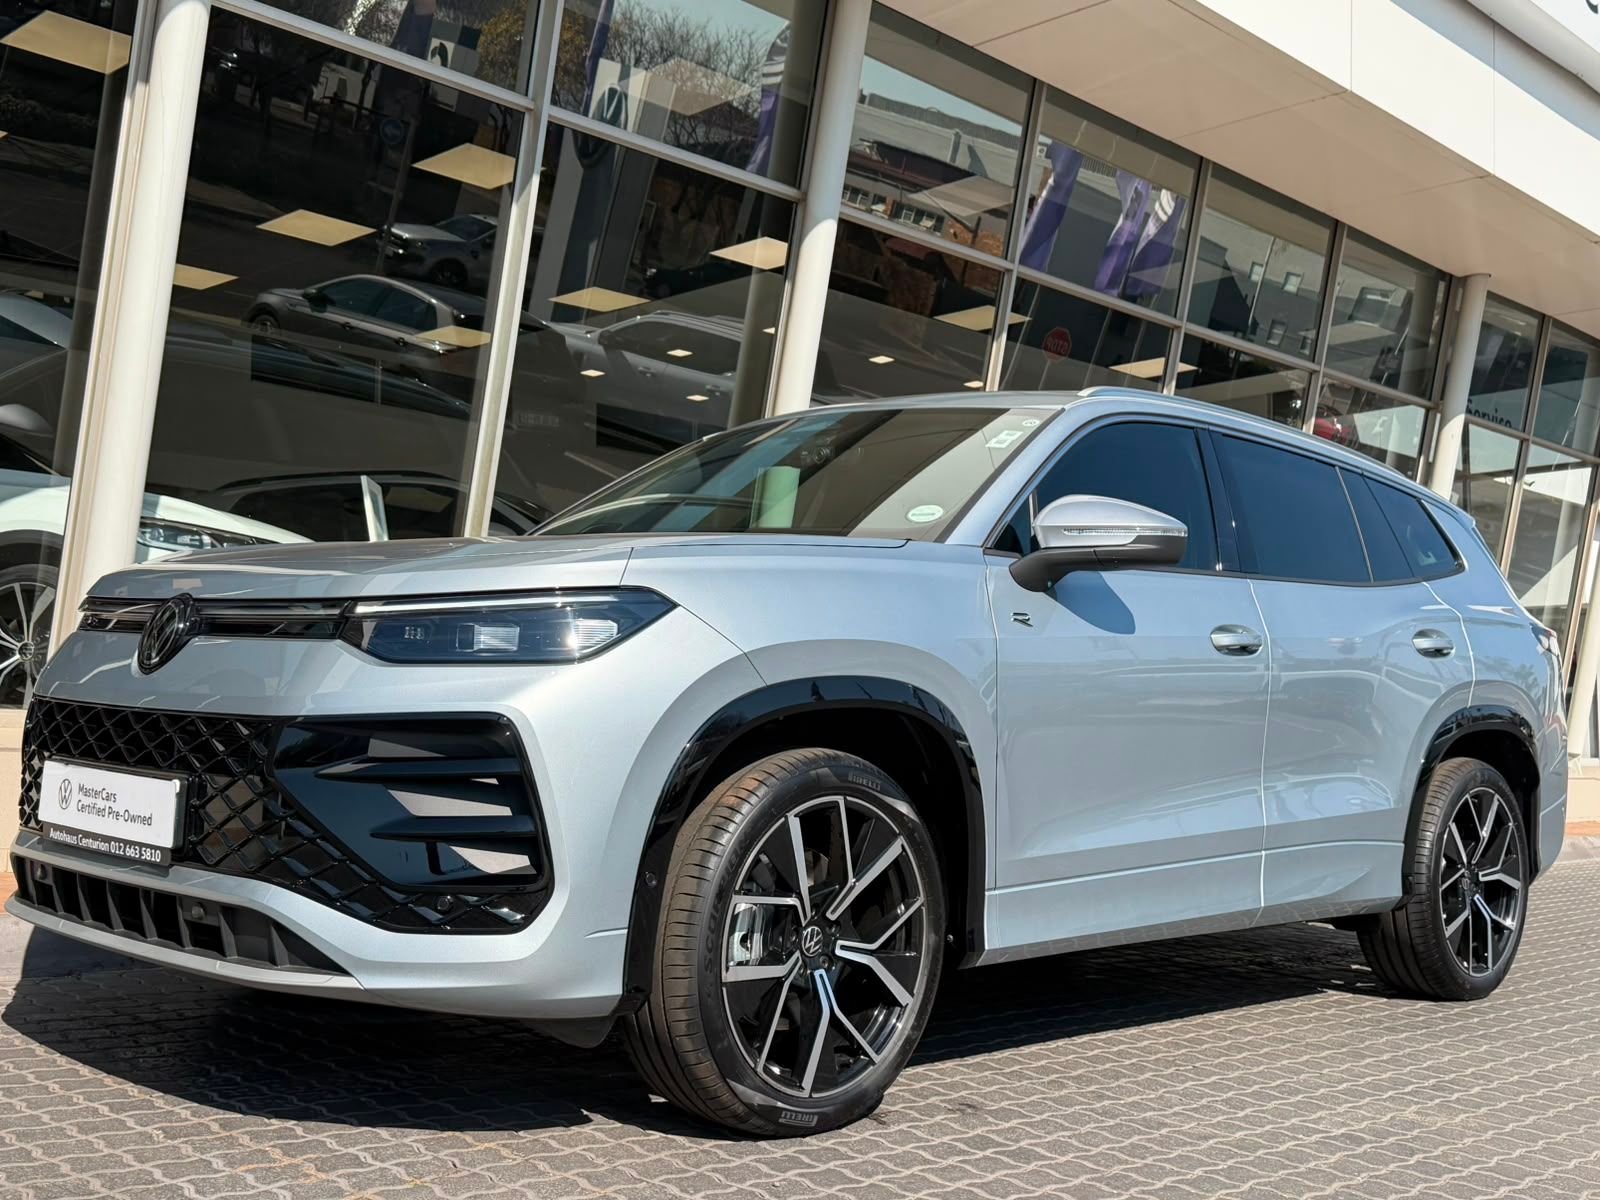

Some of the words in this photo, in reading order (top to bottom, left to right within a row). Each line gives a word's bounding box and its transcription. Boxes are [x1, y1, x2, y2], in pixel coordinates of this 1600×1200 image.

[77, 783, 117, 803] MasterCars
[76, 799, 106, 818] Certified
[107, 806, 152, 826] Pre-Owned
[49, 827, 77, 844] Autohaus
[78, 834, 110, 853] Centurion
[110, 841, 124, 854] 012
[125, 845, 140, 859] 663
[141, 848, 161, 863] 5810
[779, 1110, 819, 1127] PIRELLI
